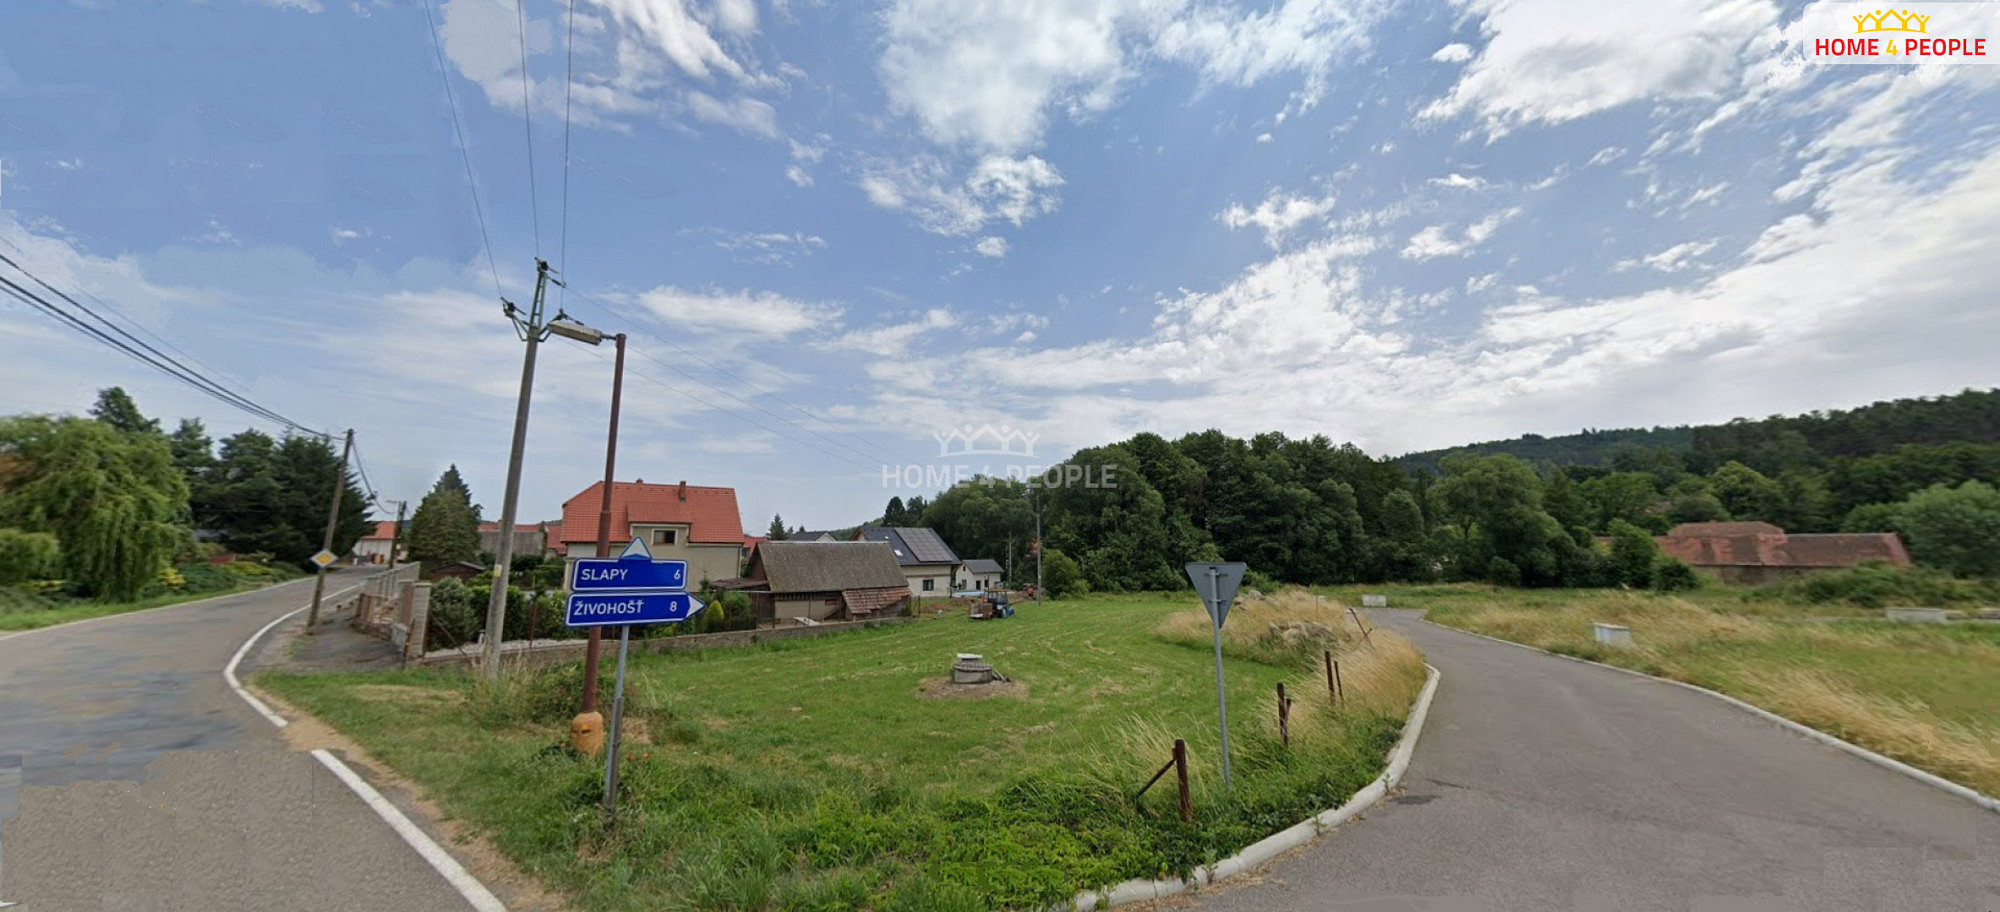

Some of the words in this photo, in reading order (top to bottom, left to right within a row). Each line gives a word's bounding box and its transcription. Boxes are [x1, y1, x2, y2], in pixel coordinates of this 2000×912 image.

[581, 568, 628, 580] SLAPY
[673, 569, 681, 580] 6
[574, 599, 644, 616] ŽIVOHOŠŤ
[669, 601, 677, 612] 8
